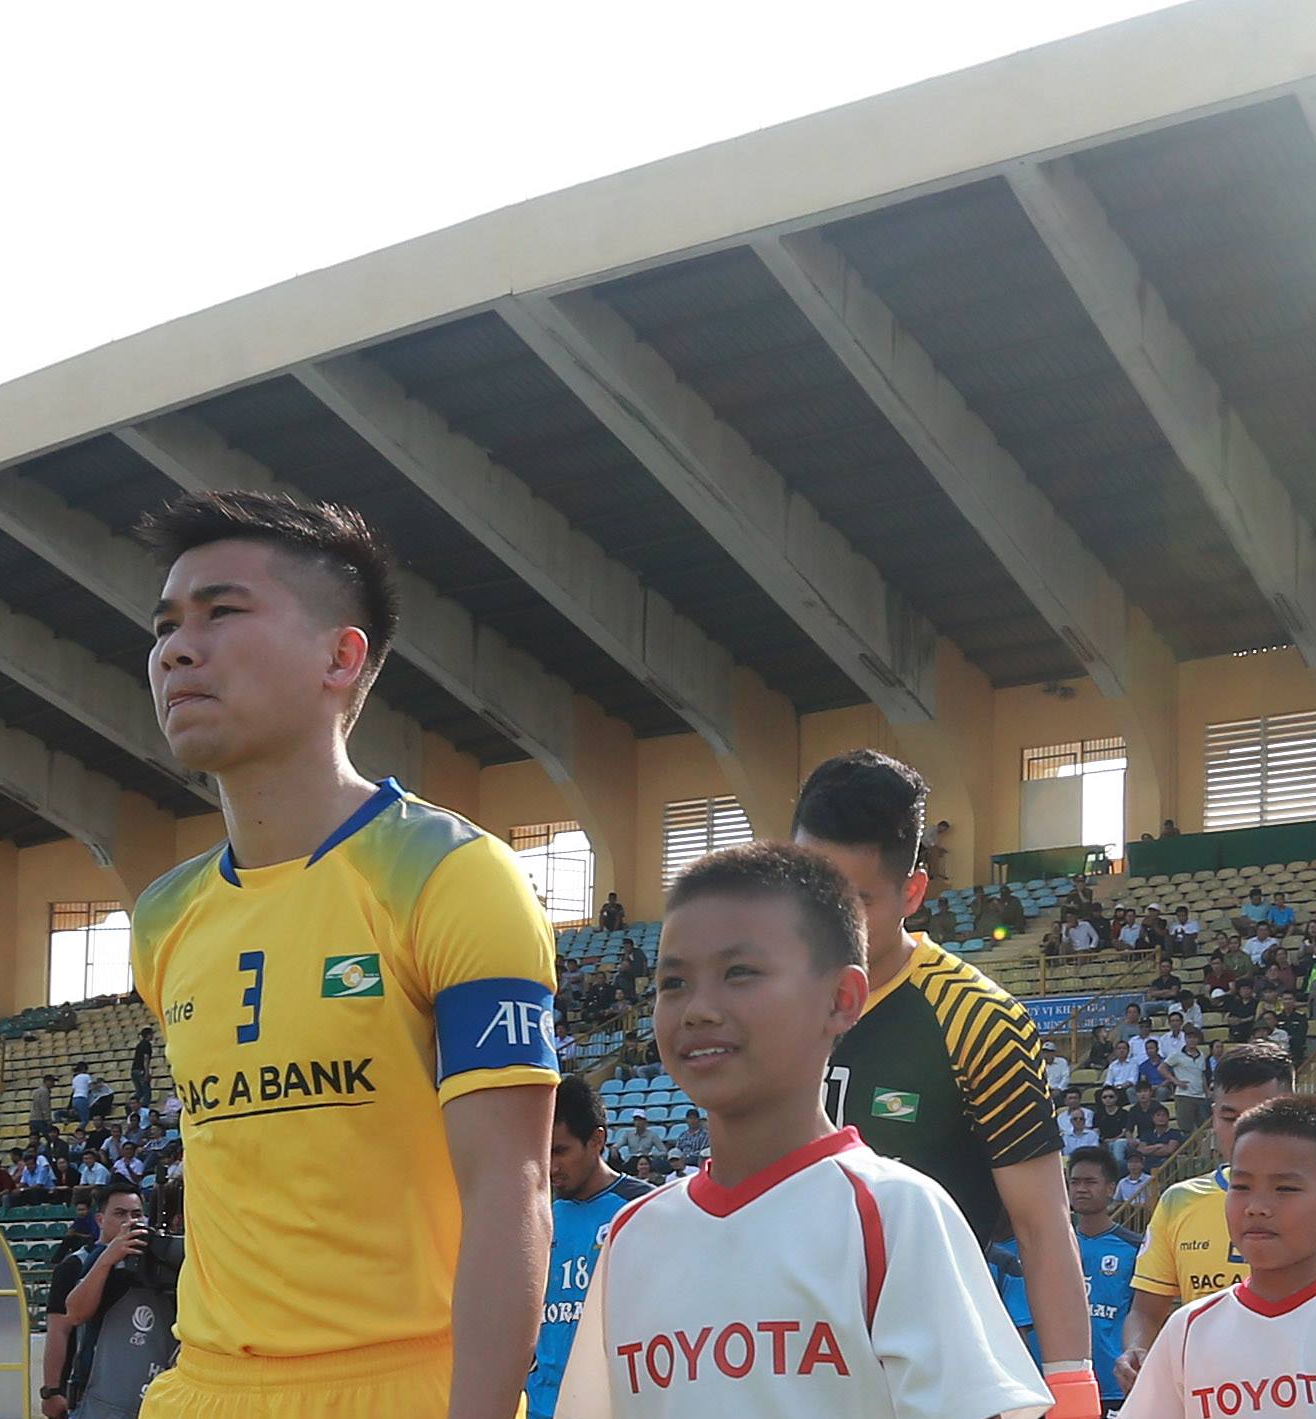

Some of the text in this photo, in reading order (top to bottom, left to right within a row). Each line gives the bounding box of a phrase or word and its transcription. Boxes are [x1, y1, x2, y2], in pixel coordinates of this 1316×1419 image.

[236, 950, 265, 1044] 3
[228, 1070, 252, 1106] A
[259, 1057, 376, 1101] BANK
[561, 1255, 590, 1291] 18
[1190, 1272, 1226, 1290] BAC
[616, 1320, 851, 1395] TOYOTA
